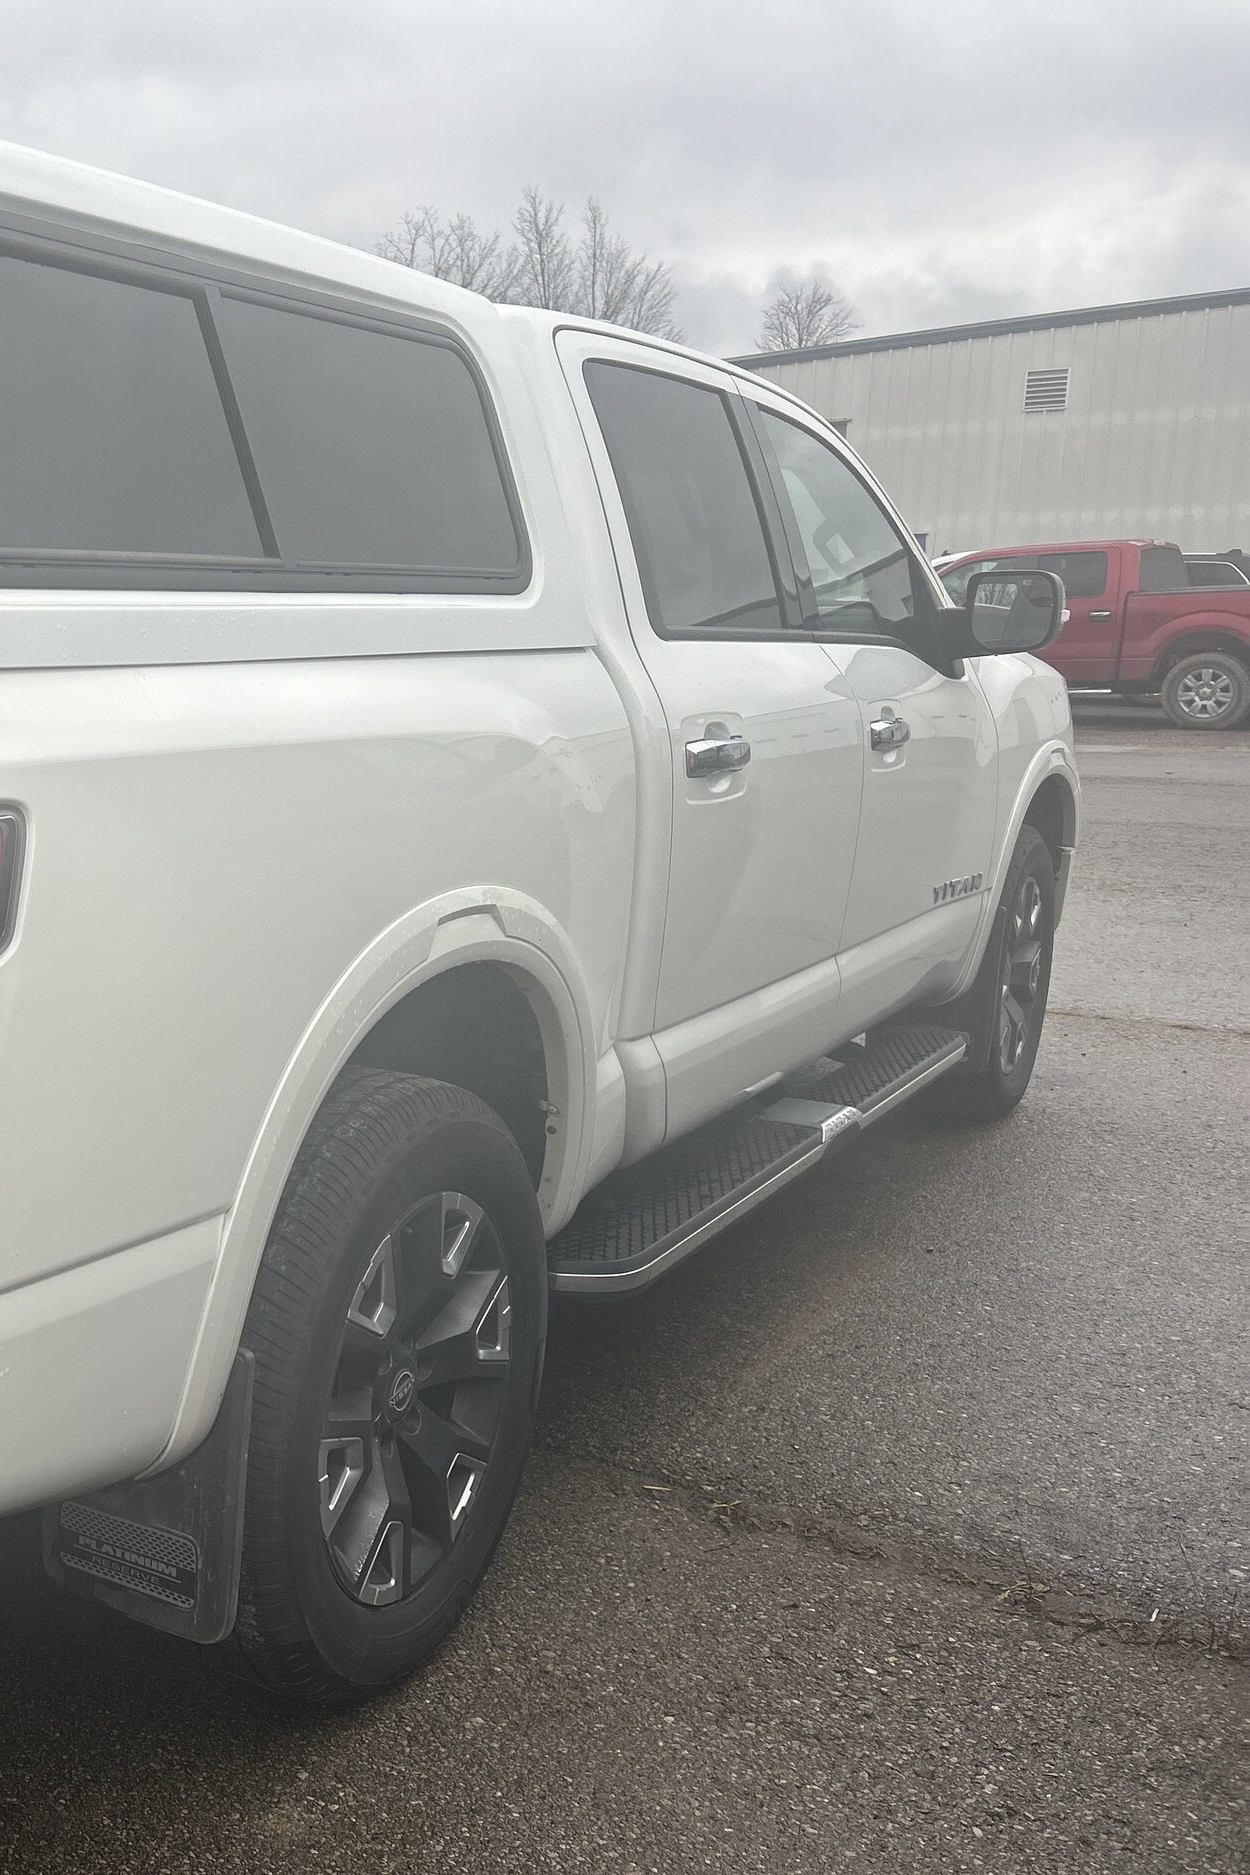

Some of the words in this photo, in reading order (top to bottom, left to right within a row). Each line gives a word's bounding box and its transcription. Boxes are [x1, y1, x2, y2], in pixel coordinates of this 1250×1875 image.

[933, 872, 983, 904] TITAN
[78, 1535, 177, 1577] PLATINUM
[92, 1555, 160, 1586] RESERVE
